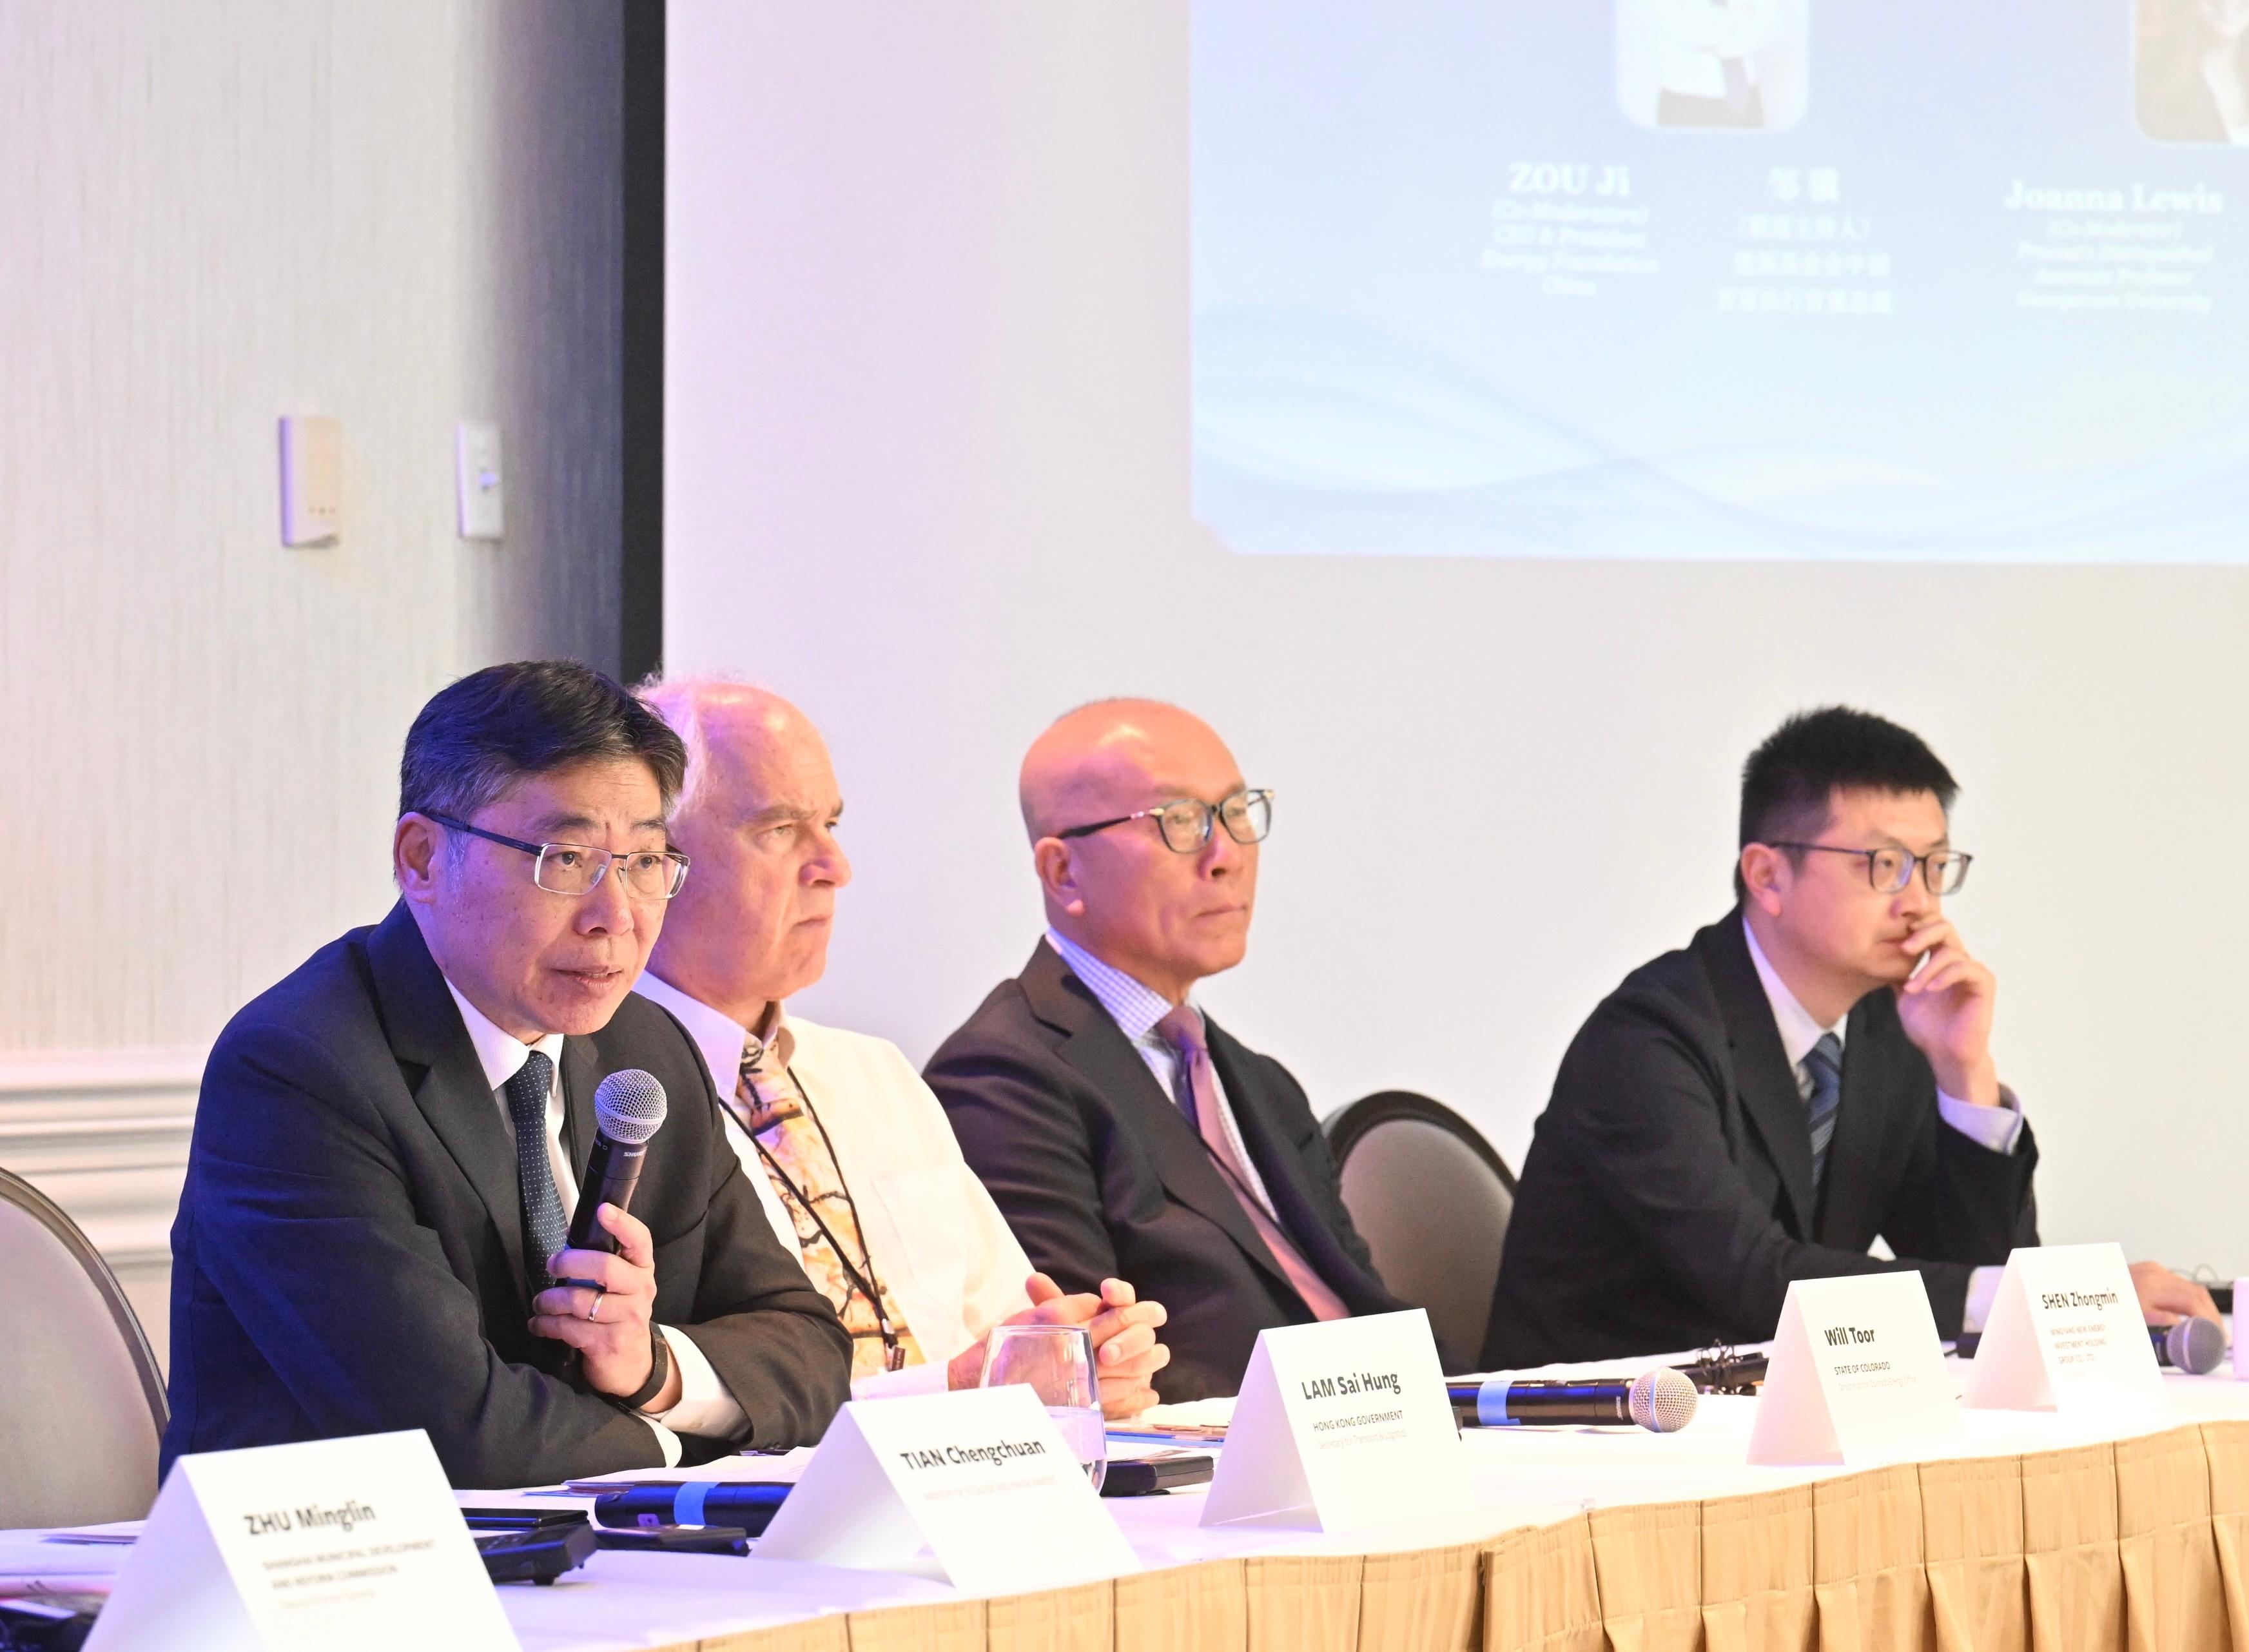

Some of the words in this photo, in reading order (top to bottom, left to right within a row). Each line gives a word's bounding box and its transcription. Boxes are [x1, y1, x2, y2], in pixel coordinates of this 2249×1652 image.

[1506, 162, 1590, 196] ZOU
[1595, 164, 1631, 197] Ji
[2003, 180, 2124, 211] Joanna
[2132, 182, 2225, 213] Lewis
[2041, 1292, 2069, 1310] SHEN
[2070, 1288, 2119, 1310] Zhongmin
[1824, 1326, 1849, 1346] Will
[1849, 1326, 1876, 1344] Toor
[1834, 1365, 1852, 1376] STATE
[1852, 1363, 1860, 1374] OF
[1860, 1361, 1891, 1373] COLORADO
[1301, 1377, 1336, 1401] LAM
[1337, 1372, 1361, 1395] Sai
[1361, 1372, 1401, 1395] Hung
[1313, 1419, 1335, 1432] HONG
[1336, 1416, 1357, 1430] KONG
[1356, 1410, 1404, 1427] GOVERNMENT
[900, 1448, 947, 1470] TIAN
[946, 1440, 1047, 1466] Chengchuan
[243, 1511, 292, 1536] ZHU
[295, 1499, 376, 1532] Minglin
